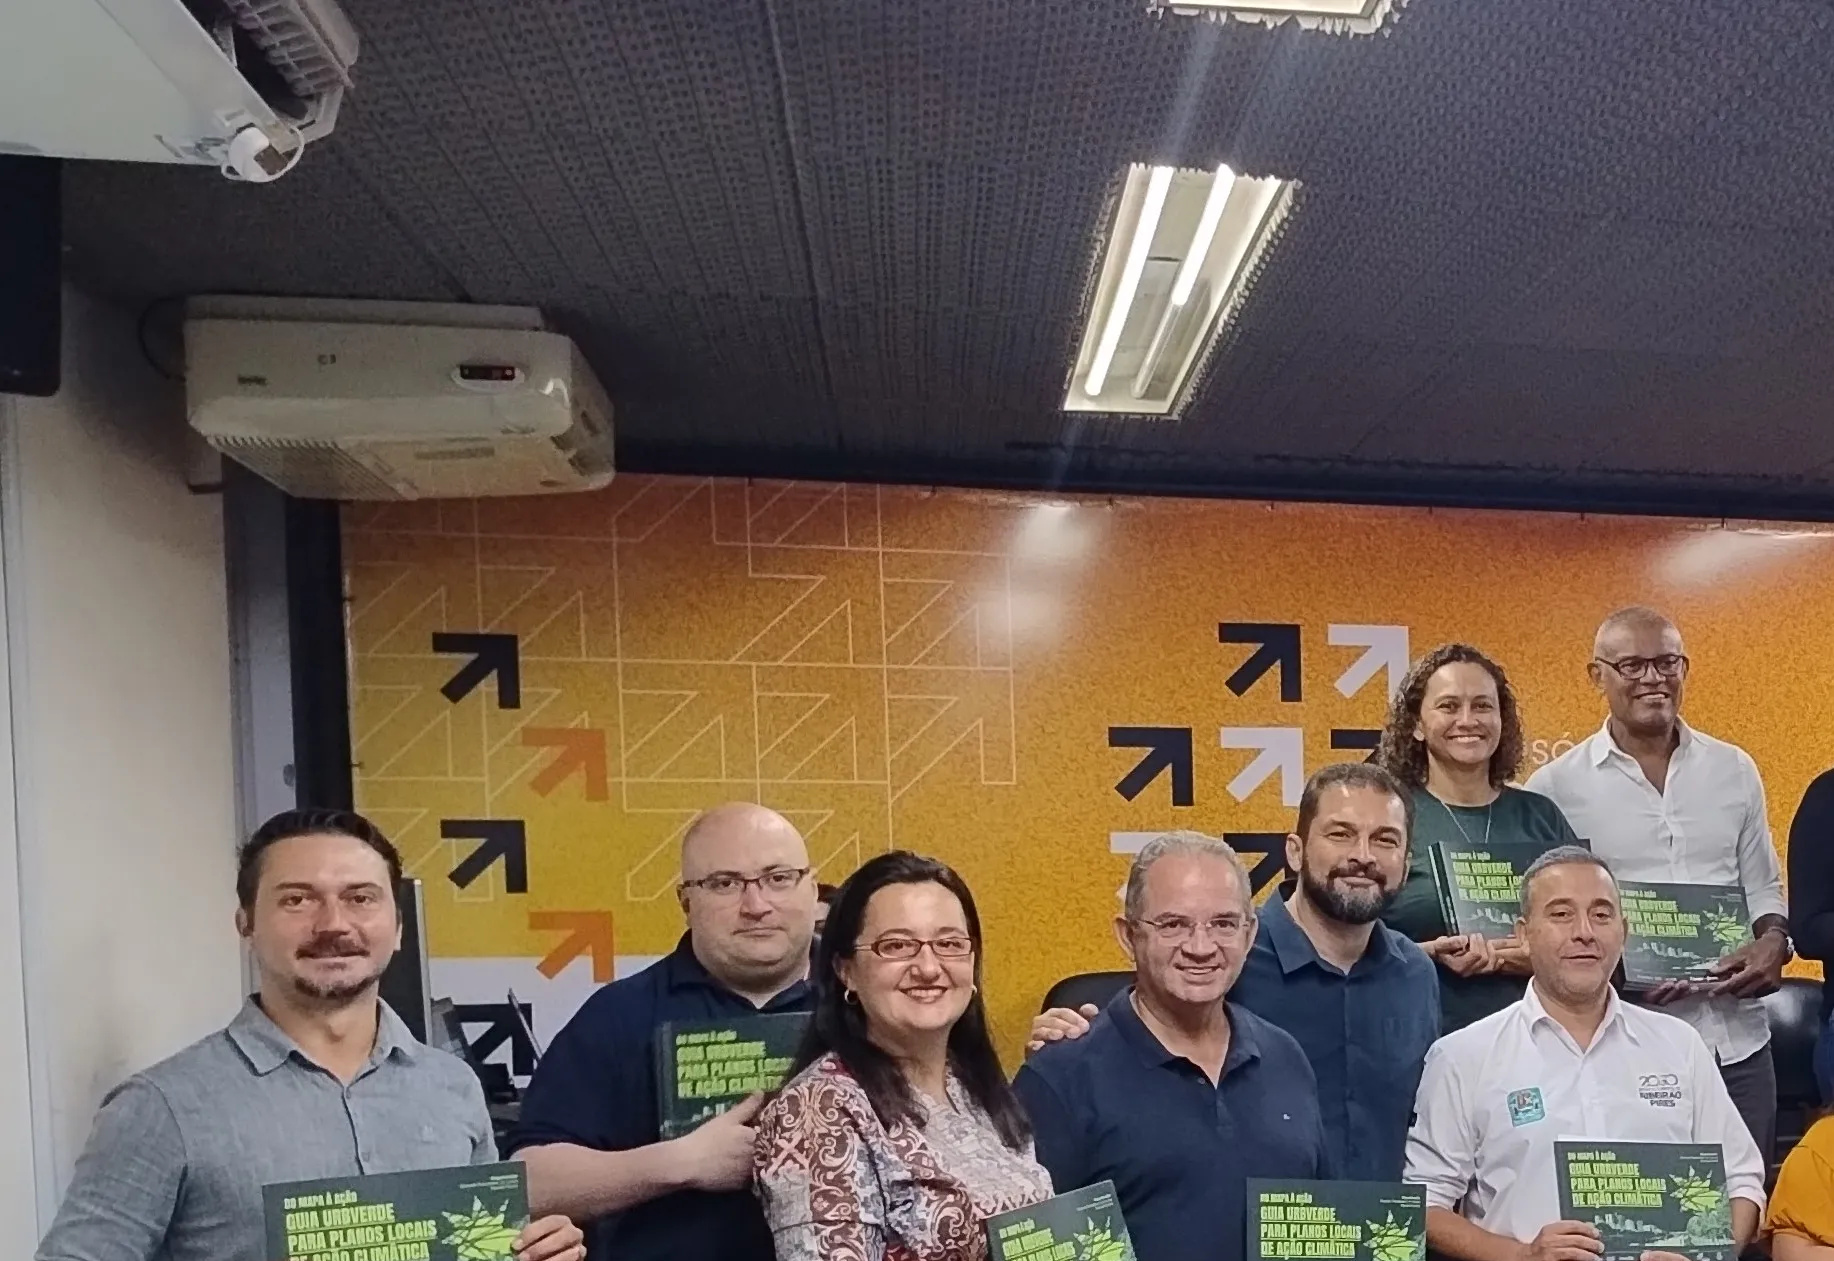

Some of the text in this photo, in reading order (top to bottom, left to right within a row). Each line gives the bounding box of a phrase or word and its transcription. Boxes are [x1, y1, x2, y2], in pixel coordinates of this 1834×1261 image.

[1569, 1163, 1640, 1176] GUIA URBVERDE
[1571, 1178, 1666, 1190] PARA PLANOS LOCAIS
[284, 1198, 297, 1209] DO
[298, 1195, 324, 1207] MAPA
[333, 1189, 359, 1207] AÇÃO
[1572, 1191, 1662, 1209] DE AÇÃO CLIMÁTICA
[286, 1202, 395, 1231] GUIA URBVERDE
[1261, 1206, 1336, 1221] GUIA URBVERDE
[288, 1219, 437, 1250] PARA PLANOS LOCAIS
[1261, 1224, 1361, 1239] PARA PLANOS LOCAIS
[1261, 1239, 1354, 1260] DE AÇÃO CLIMÁTICA
